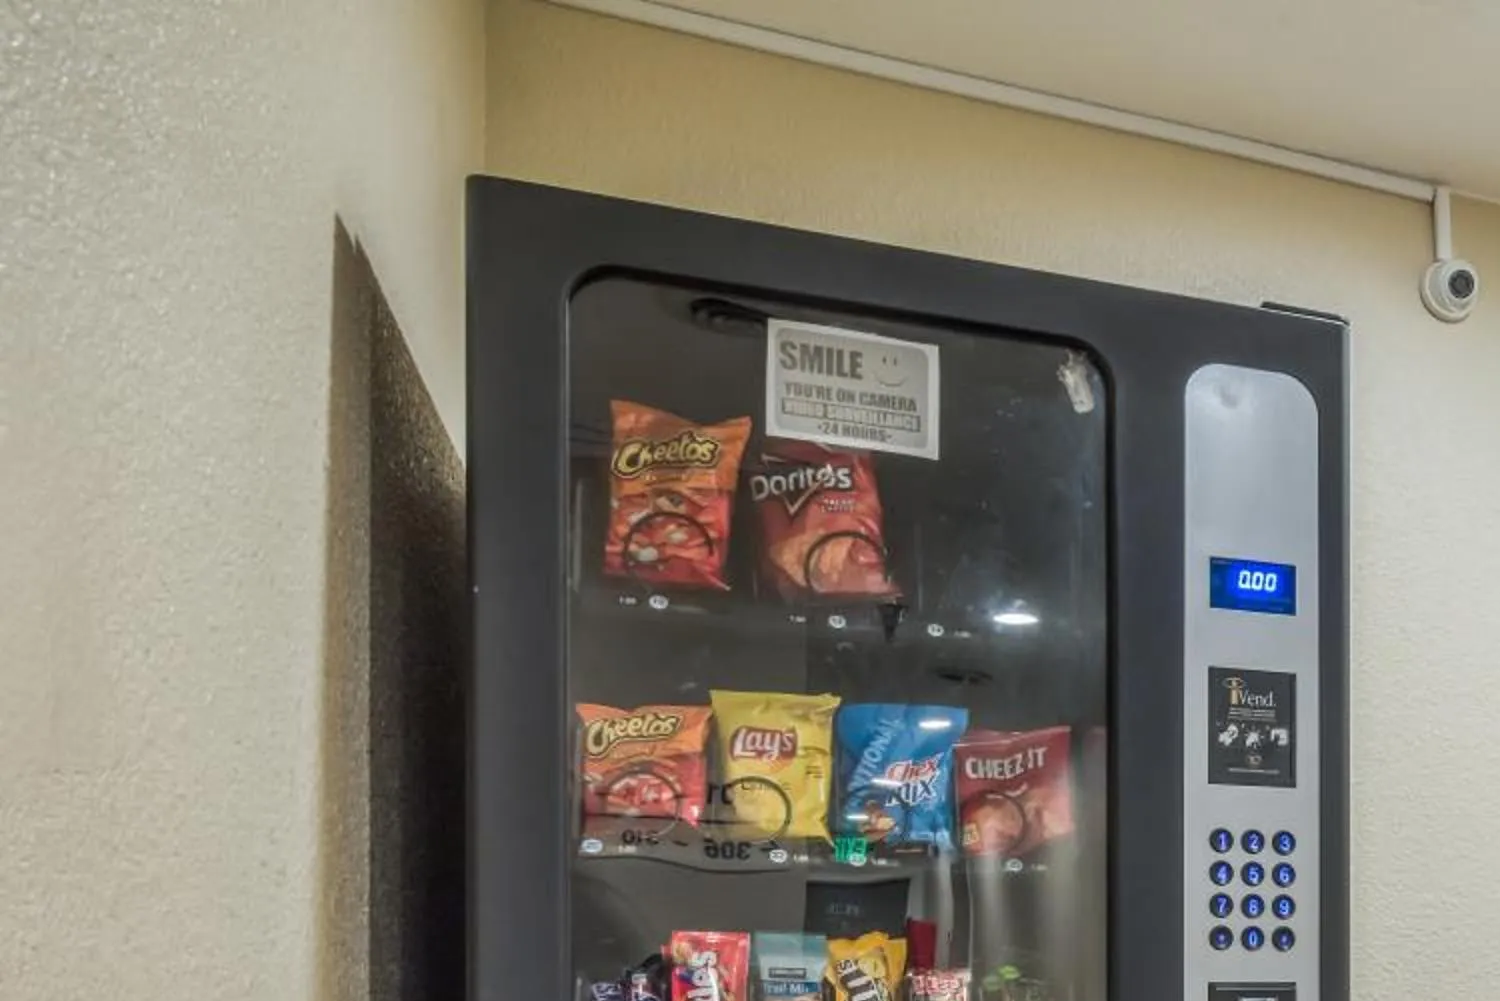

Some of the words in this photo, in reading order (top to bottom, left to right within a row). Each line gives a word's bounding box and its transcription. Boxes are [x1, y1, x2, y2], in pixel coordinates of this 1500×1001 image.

[779, 340, 863, 379] SMILE
[785, 381, 832, 400] YOU'RE
[836, 388, 855, 402] ON
[859, 391, 918, 412] CAMERA
[612, 432, 719, 477] Cheetos
[751, 464, 852, 500] Doritos
[586, 713, 682, 757] Cheetos
[733, 727, 795, 761] Lay's
[1219, 832, 1227, 850] 1
[1249, 834, 1259, 850] 2
[1281, 834, 1291, 851] 3
[1217, 865, 1227, 882] 4
[1249, 867, 1259, 882] 5
[1280, 867, 1289, 883] 6
[1217, 897, 1227, 913] 7
[1280, 899, 1289, 915] 9
[1249, 930, 1257, 947] 0
